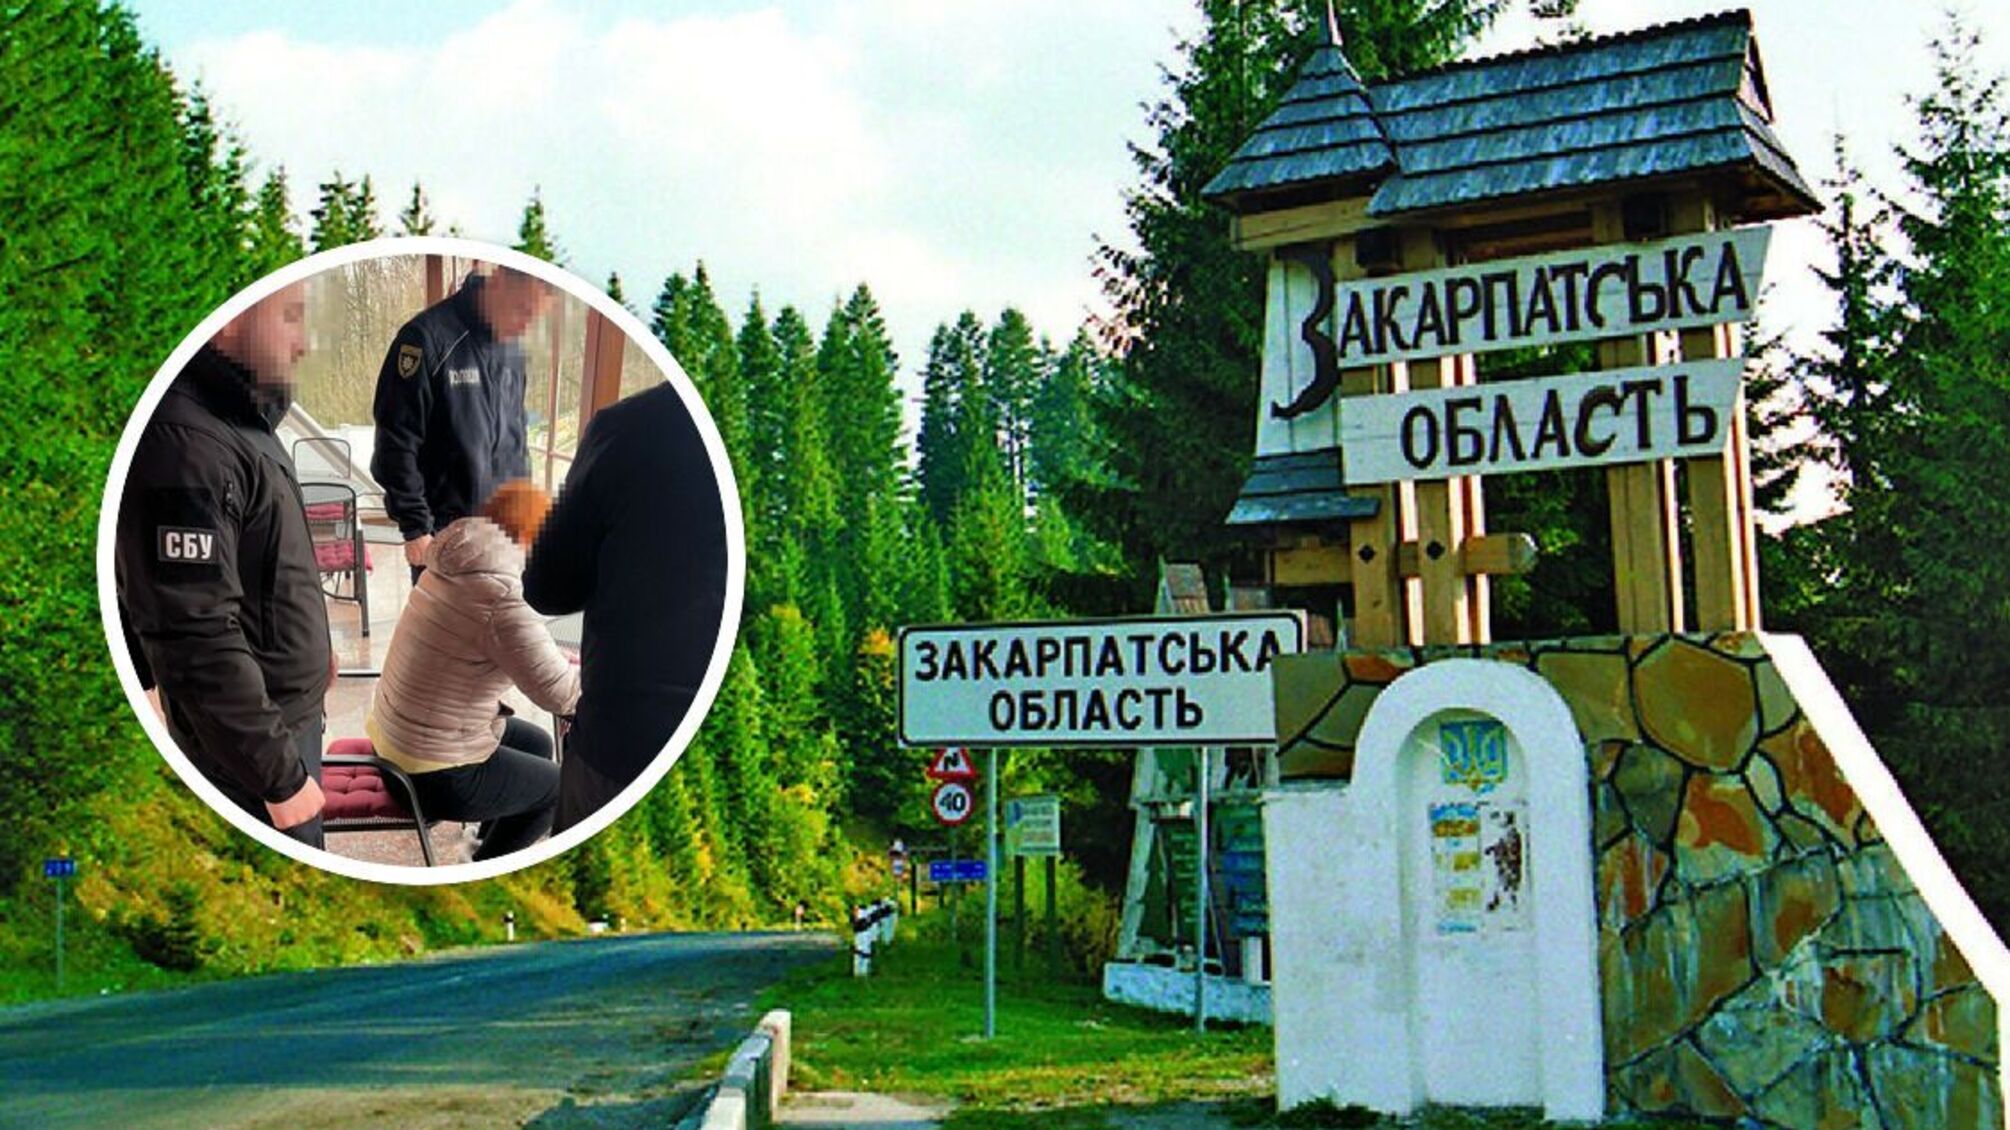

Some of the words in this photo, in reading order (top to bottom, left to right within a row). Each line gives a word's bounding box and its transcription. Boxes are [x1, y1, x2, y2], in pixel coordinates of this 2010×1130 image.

[1271, 241, 1750, 420] ЗАКАРПАТСЬКА
[1402, 375, 1718, 470] ОБЛАСТЬ
[166, 532, 212, 559] СБУ
[915, 630, 1279, 681] ЗАКАРПАТСЬКА
[989, 688, 1204, 731] ОБЛАСТЬ
[939, 792, 966, 812] 40
